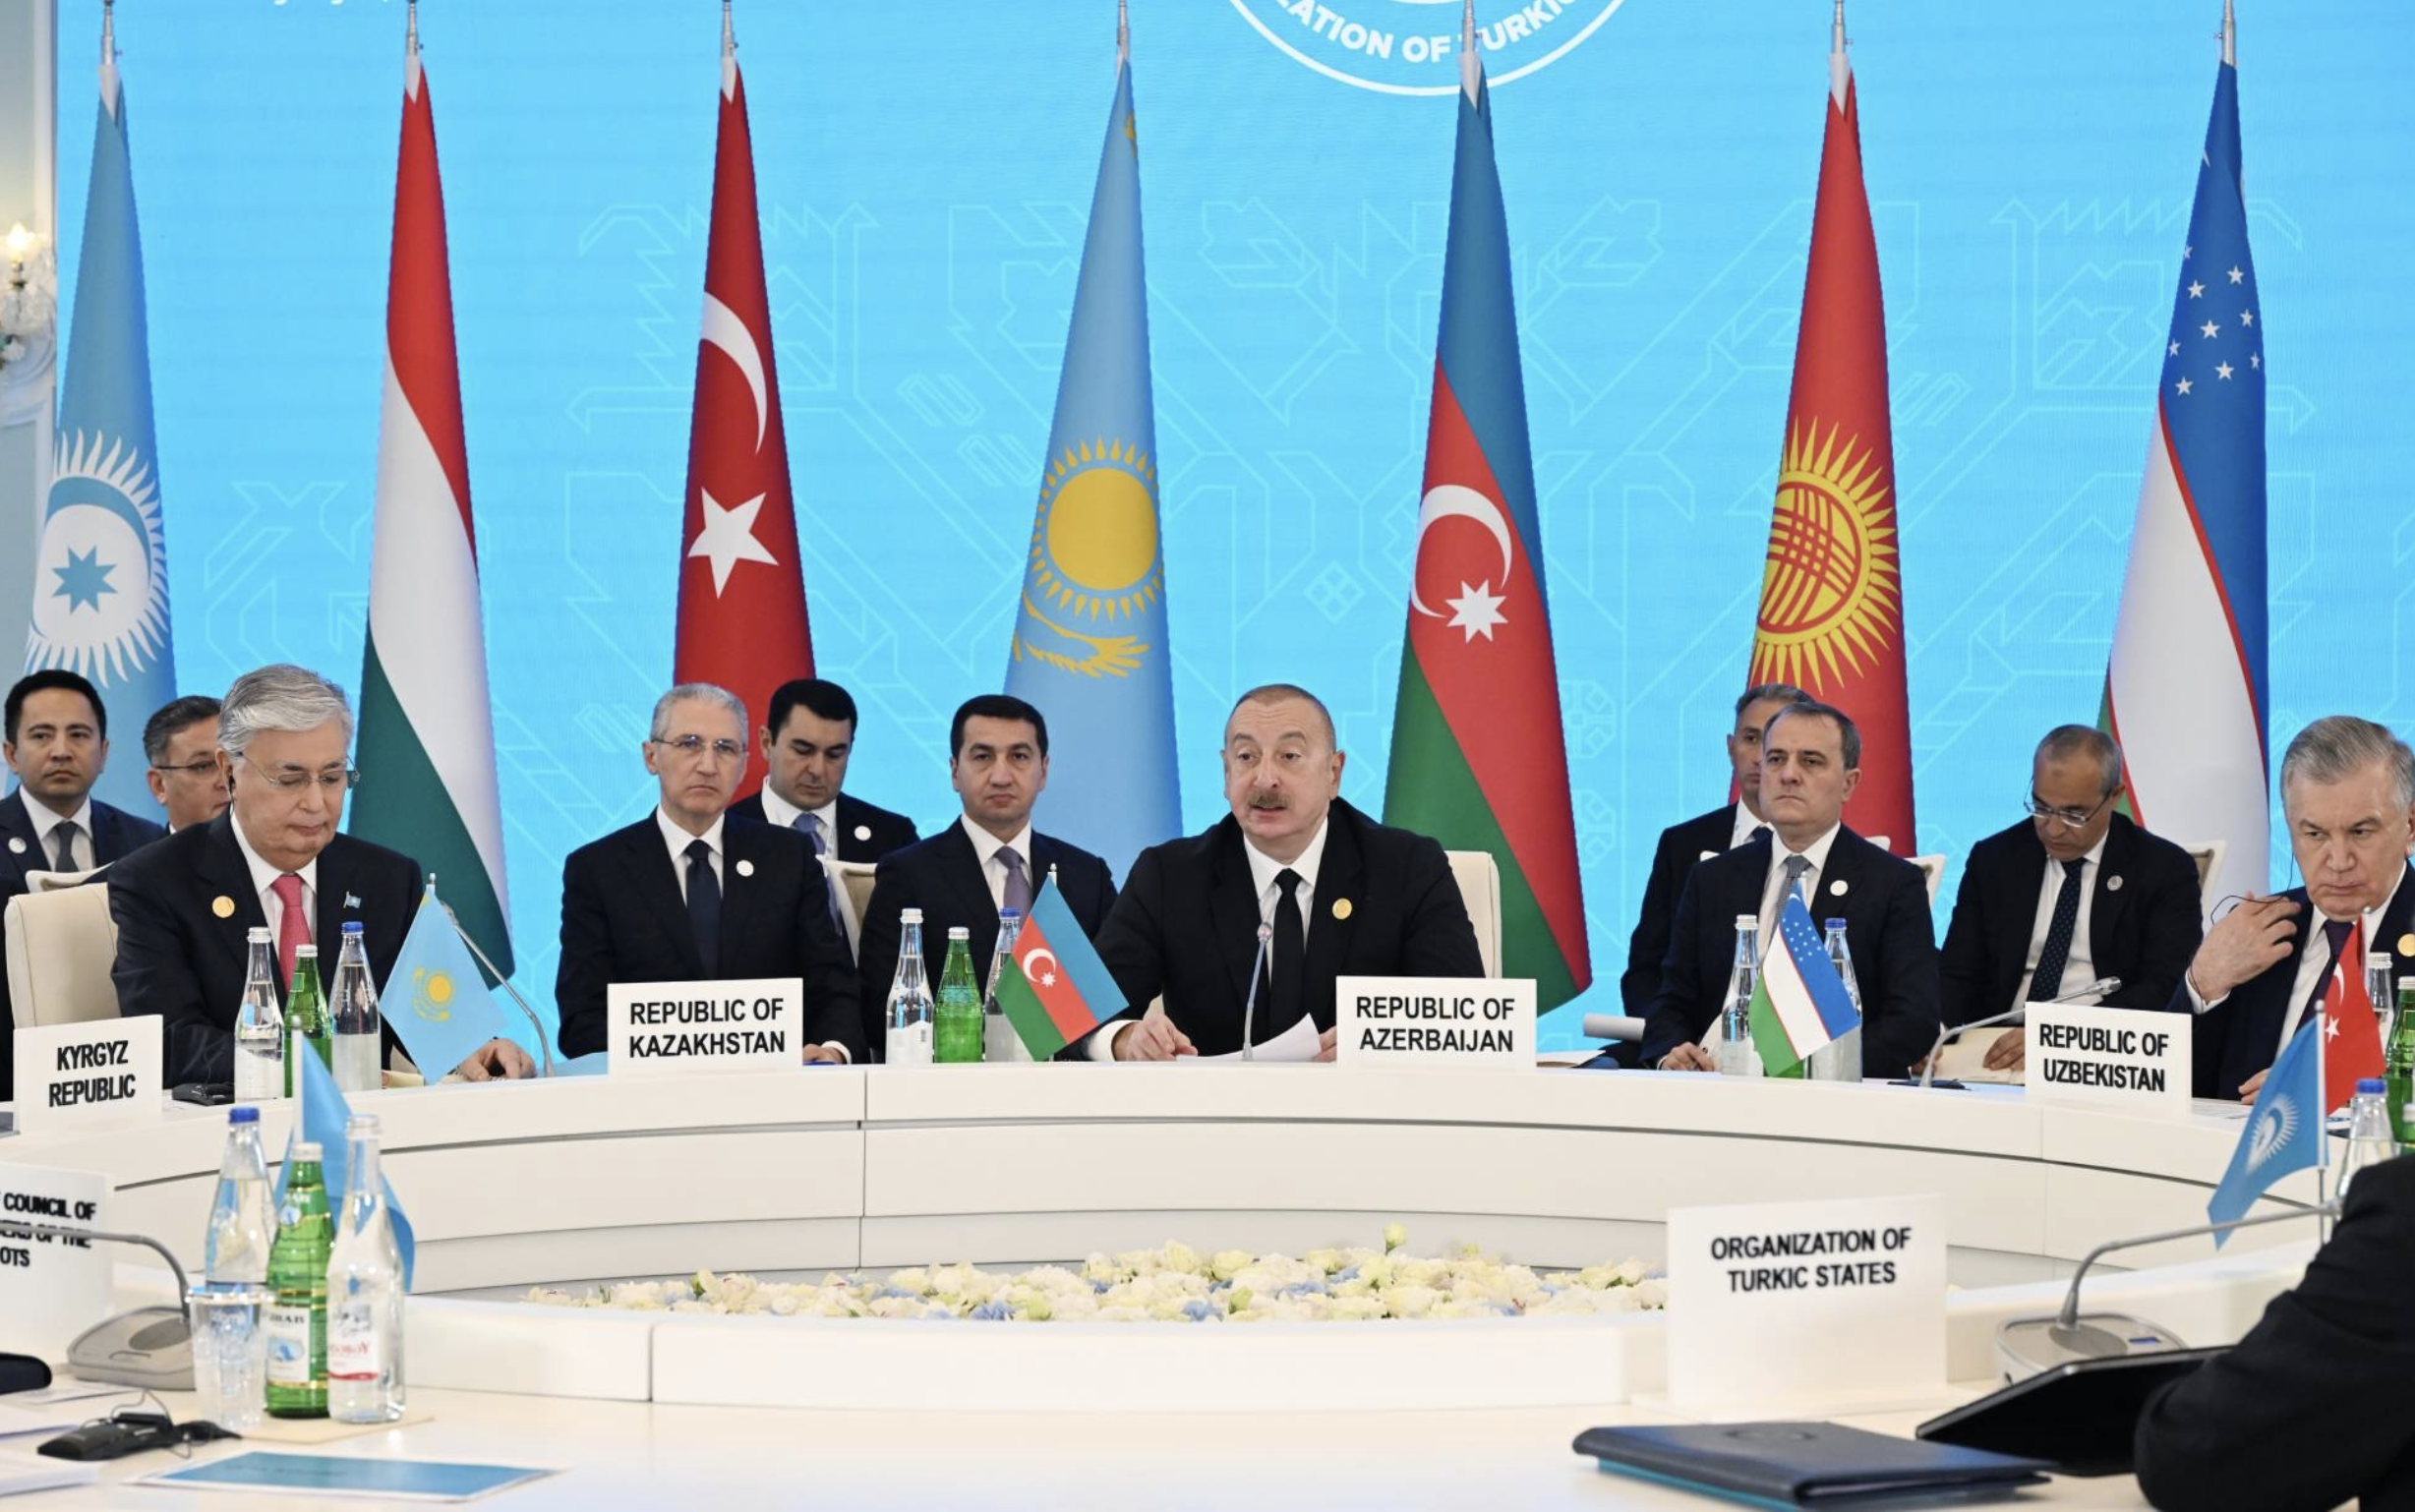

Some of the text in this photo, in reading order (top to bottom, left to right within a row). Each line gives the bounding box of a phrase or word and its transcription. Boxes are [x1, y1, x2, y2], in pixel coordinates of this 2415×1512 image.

[1276, 0, 1577, 63] ATION OF URKI
[631, 998, 783, 1024] REPUBLIC OF
[1357, 997, 1514, 1019] REPUBLIC OF
[630, 1031, 785, 1058] KAZAKHSTAN
[1360, 1028, 1512, 1052] AZERBAIJAN
[2040, 1023, 2168, 1057] REPUBLIC OF
[58, 1040, 128, 1071] KYRGYZ
[2044, 1059, 2164, 1092] UZBEKISTAN
[49, 1075, 136, 1107] REPUBLIC
[4, 1192, 96, 1220] COUNCIL OF
[1712, 1228, 1911, 1259] ORGANIZATION OF
[1729, 1261, 1895, 1291] TURKIC STATES
